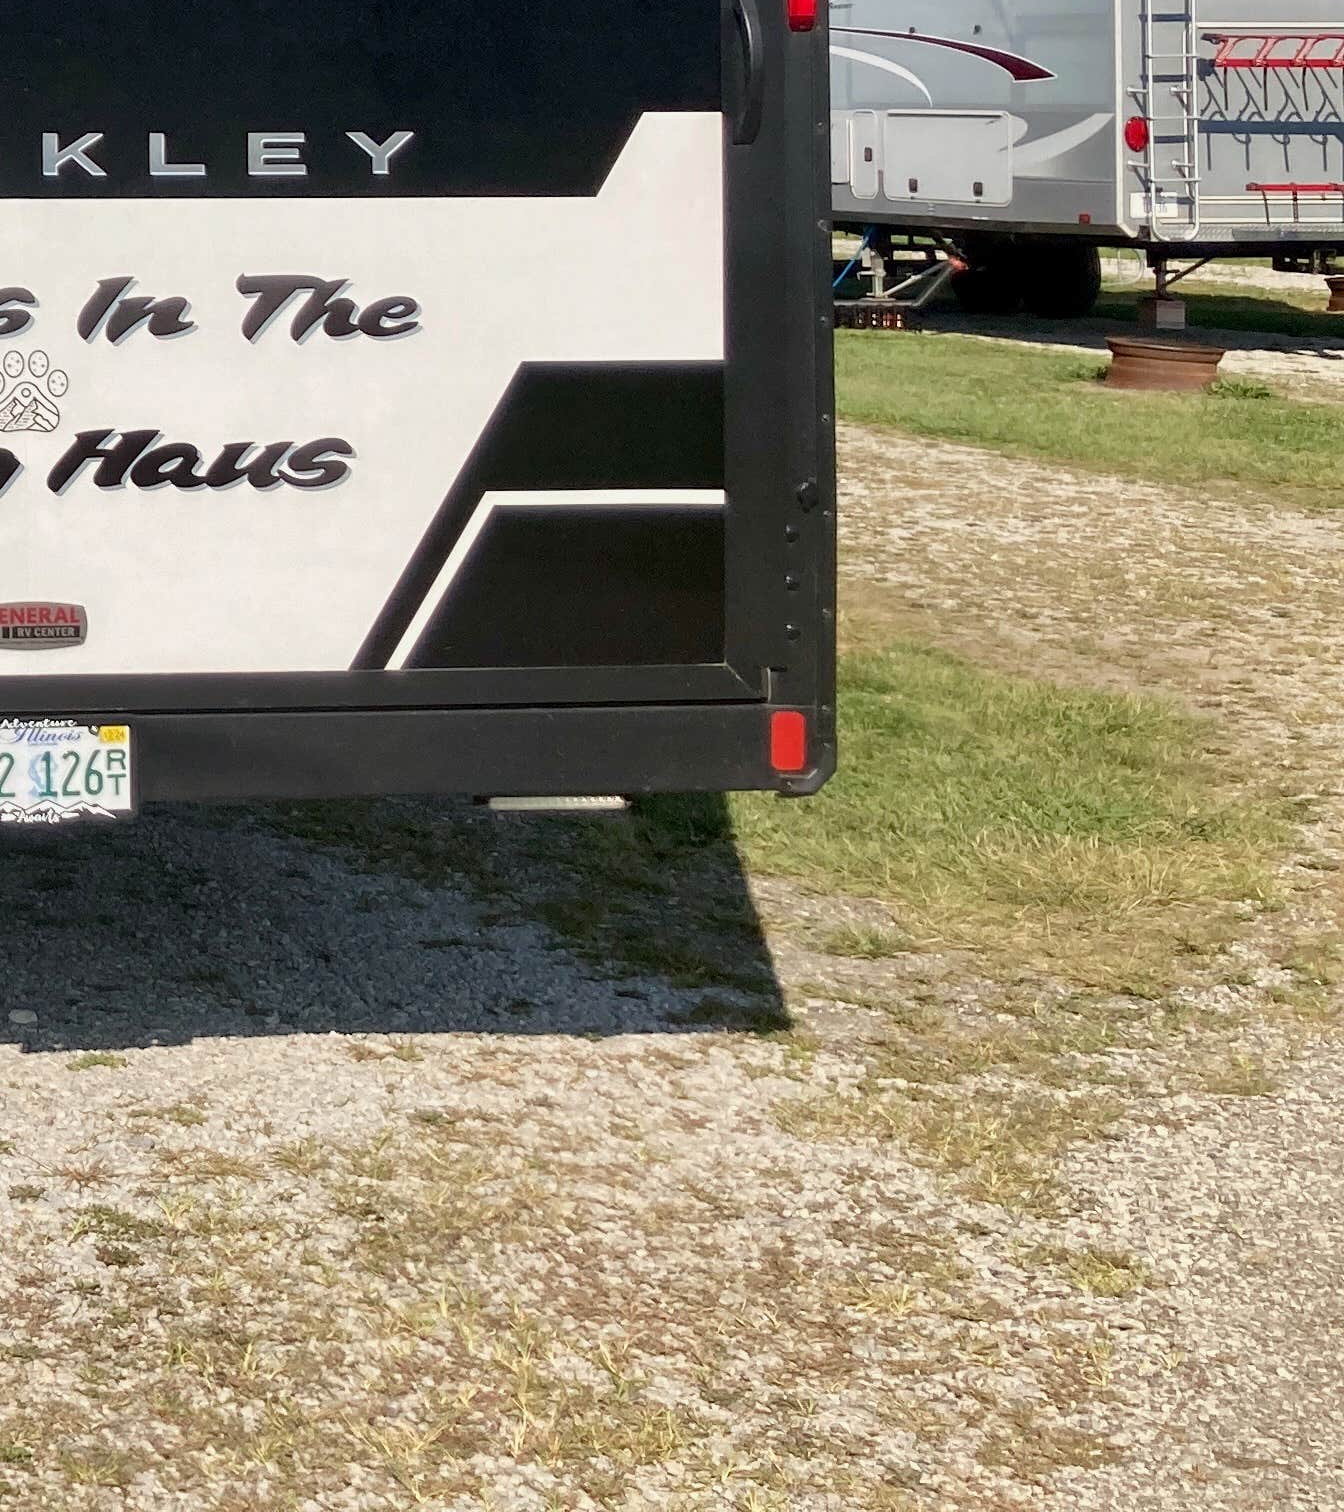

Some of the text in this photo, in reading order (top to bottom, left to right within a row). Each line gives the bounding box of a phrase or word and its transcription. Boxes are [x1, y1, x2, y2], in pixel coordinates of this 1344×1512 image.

[76, 275, 199, 347] In
[235, 272, 424, 345] The
[46, 428, 358, 494] Haus
[17, 626, 75, 637] RV CENTER
[14, 726, 83, 742] Illinois
[39, 749, 104, 798] 126
